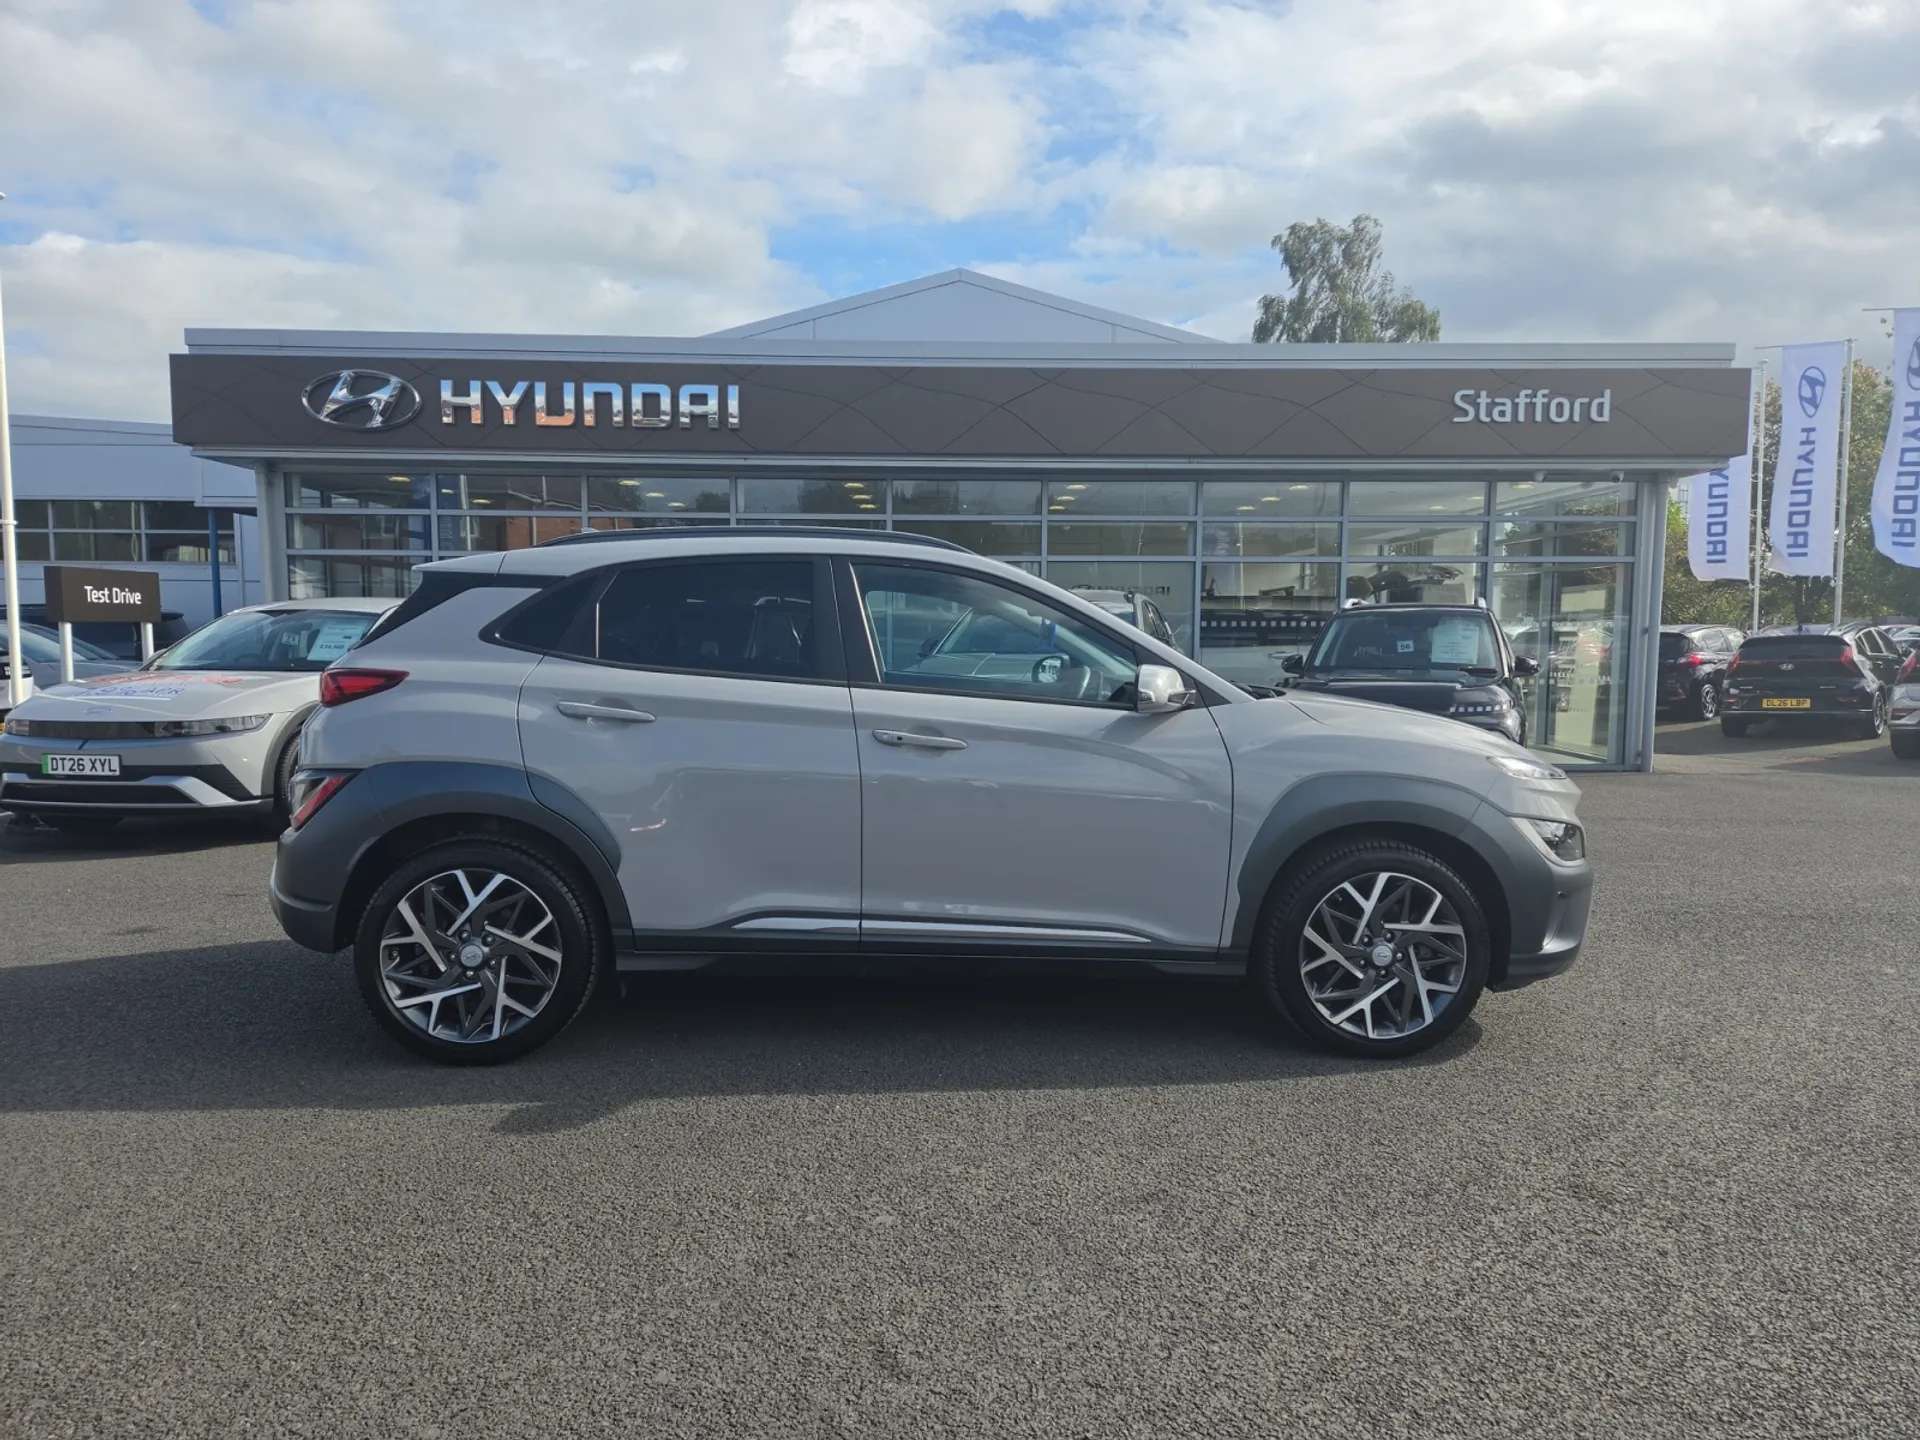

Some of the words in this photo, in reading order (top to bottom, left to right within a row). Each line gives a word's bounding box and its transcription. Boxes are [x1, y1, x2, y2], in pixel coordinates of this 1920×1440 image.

[439, 379, 740, 430] HYUNDAI
[1452, 388, 1612, 424] Stafford
[1786, 426, 1817, 559] HYUNDAI
[1706, 469, 1729, 564] YUNDAI
[84, 585, 110, 604] Test
[111, 587, 142, 605] Drive
[50, 757, 86, 772] DT26
[89, 758, 117, 773] XYL
